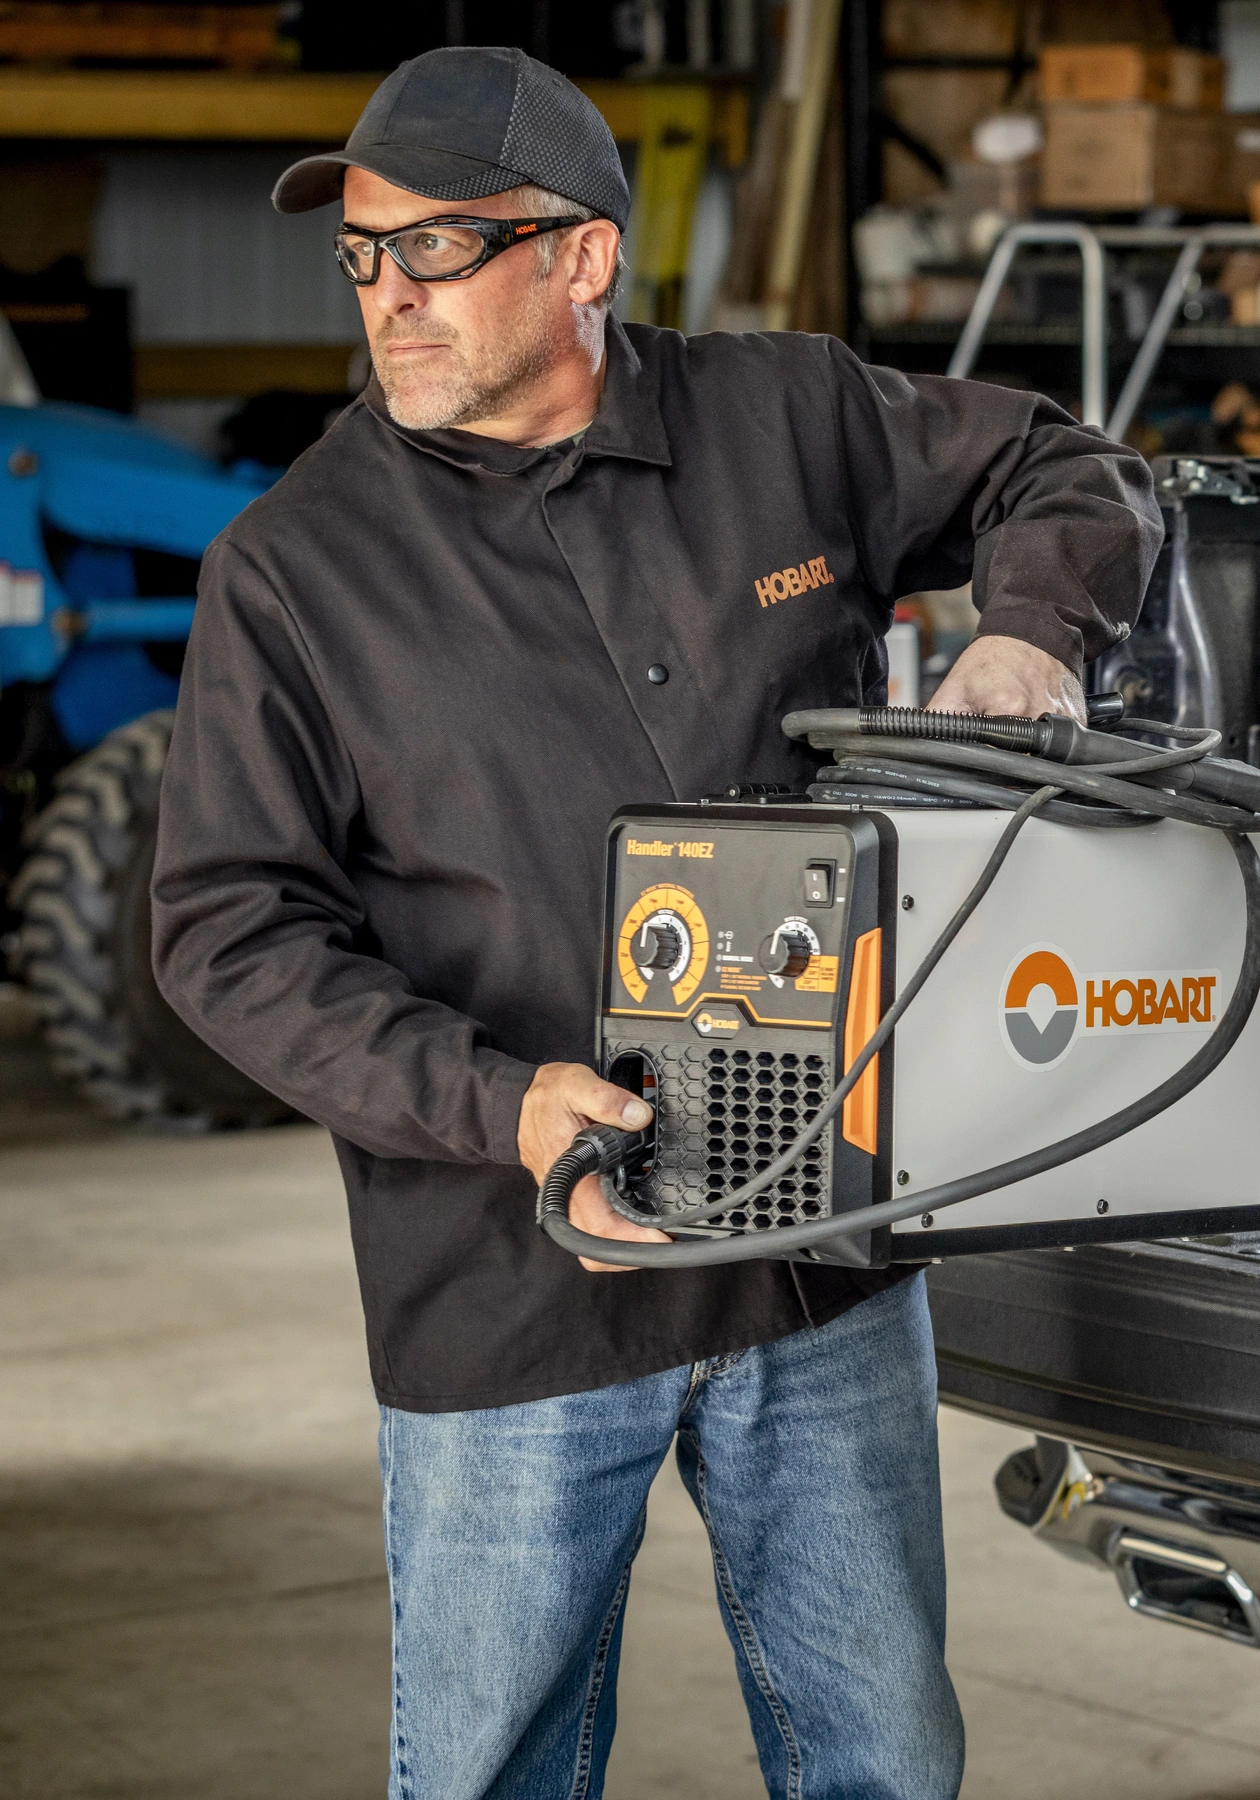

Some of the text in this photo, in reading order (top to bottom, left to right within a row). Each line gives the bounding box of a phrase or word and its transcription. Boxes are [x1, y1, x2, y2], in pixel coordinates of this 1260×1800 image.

[515, 223, 537, 235] HOBART
[754, 555, 830, 608] HOBART
[626, 839, 715, 859] Handler 140EZ
[1086, 976, 1216, 1028] HOBART
